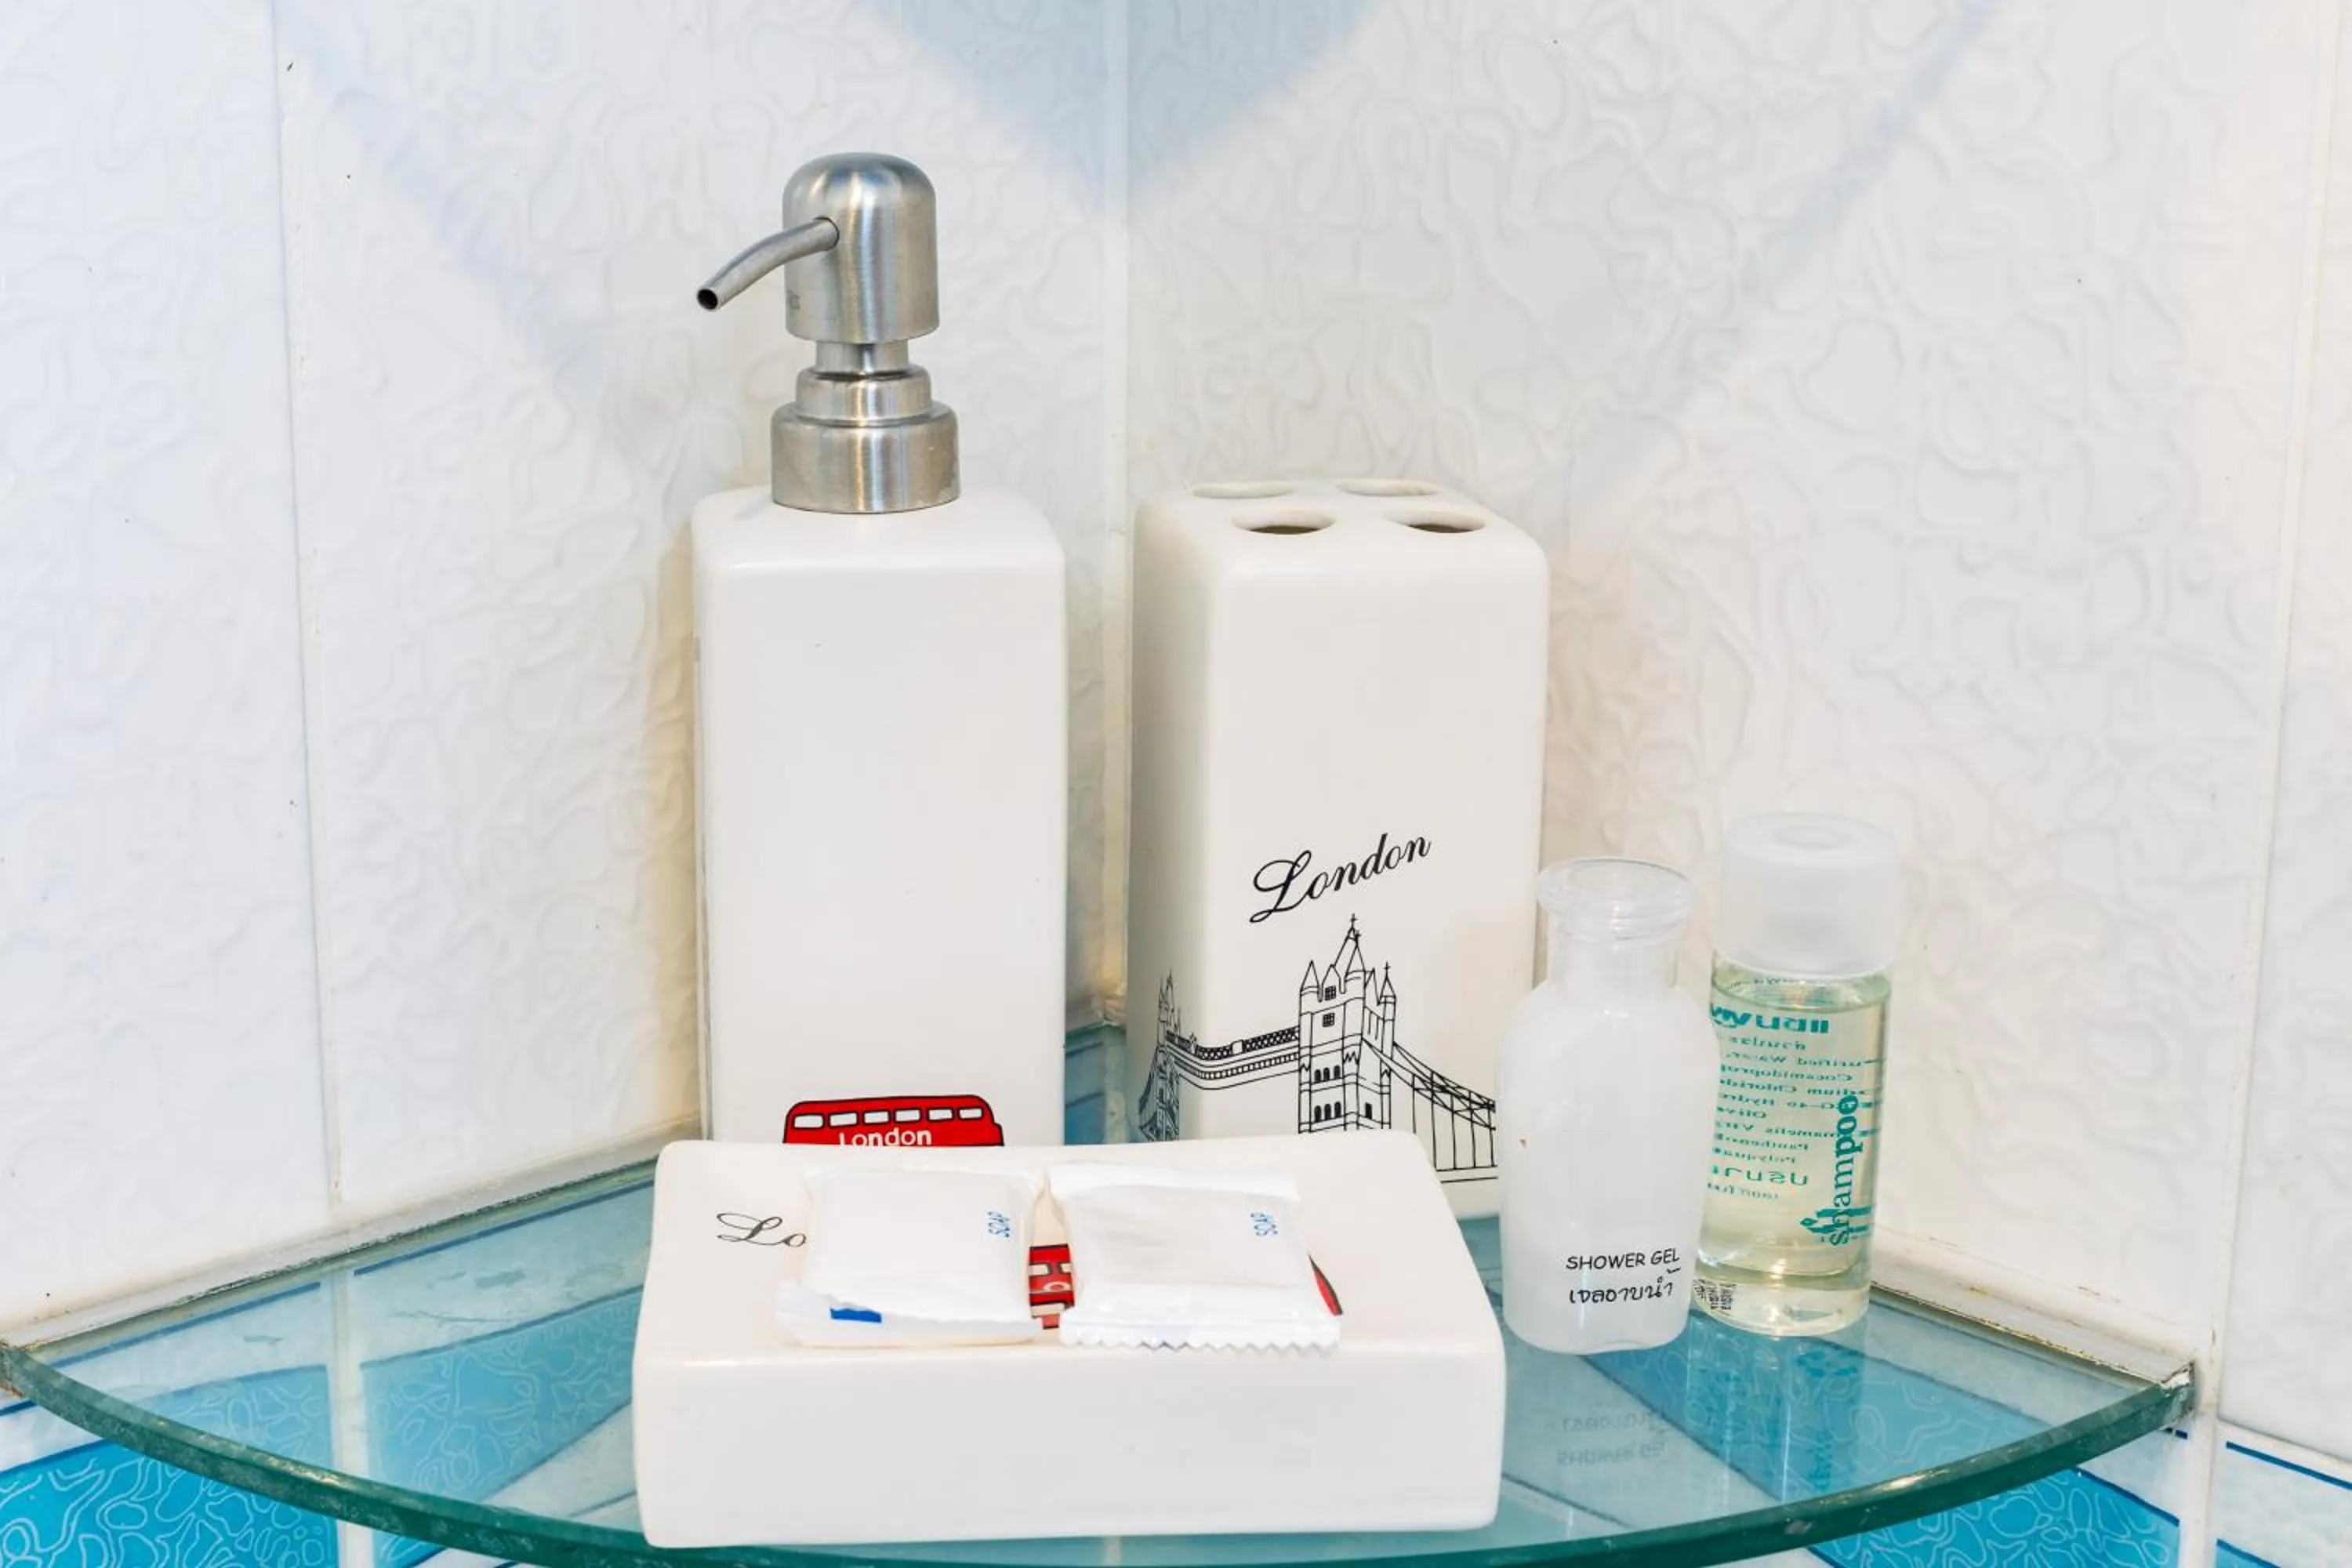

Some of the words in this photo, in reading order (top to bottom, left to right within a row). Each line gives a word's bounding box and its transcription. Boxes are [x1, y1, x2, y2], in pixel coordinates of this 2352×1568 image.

[1250, 833, 1432, 923] London
[839, 1127, 932, 1146] London
[1829, 1094, 1863, 1247] shampoo
[1566, 1253, 1646, 1270] SHOWER
[1650, 1247, 1681, 1265] GEL
